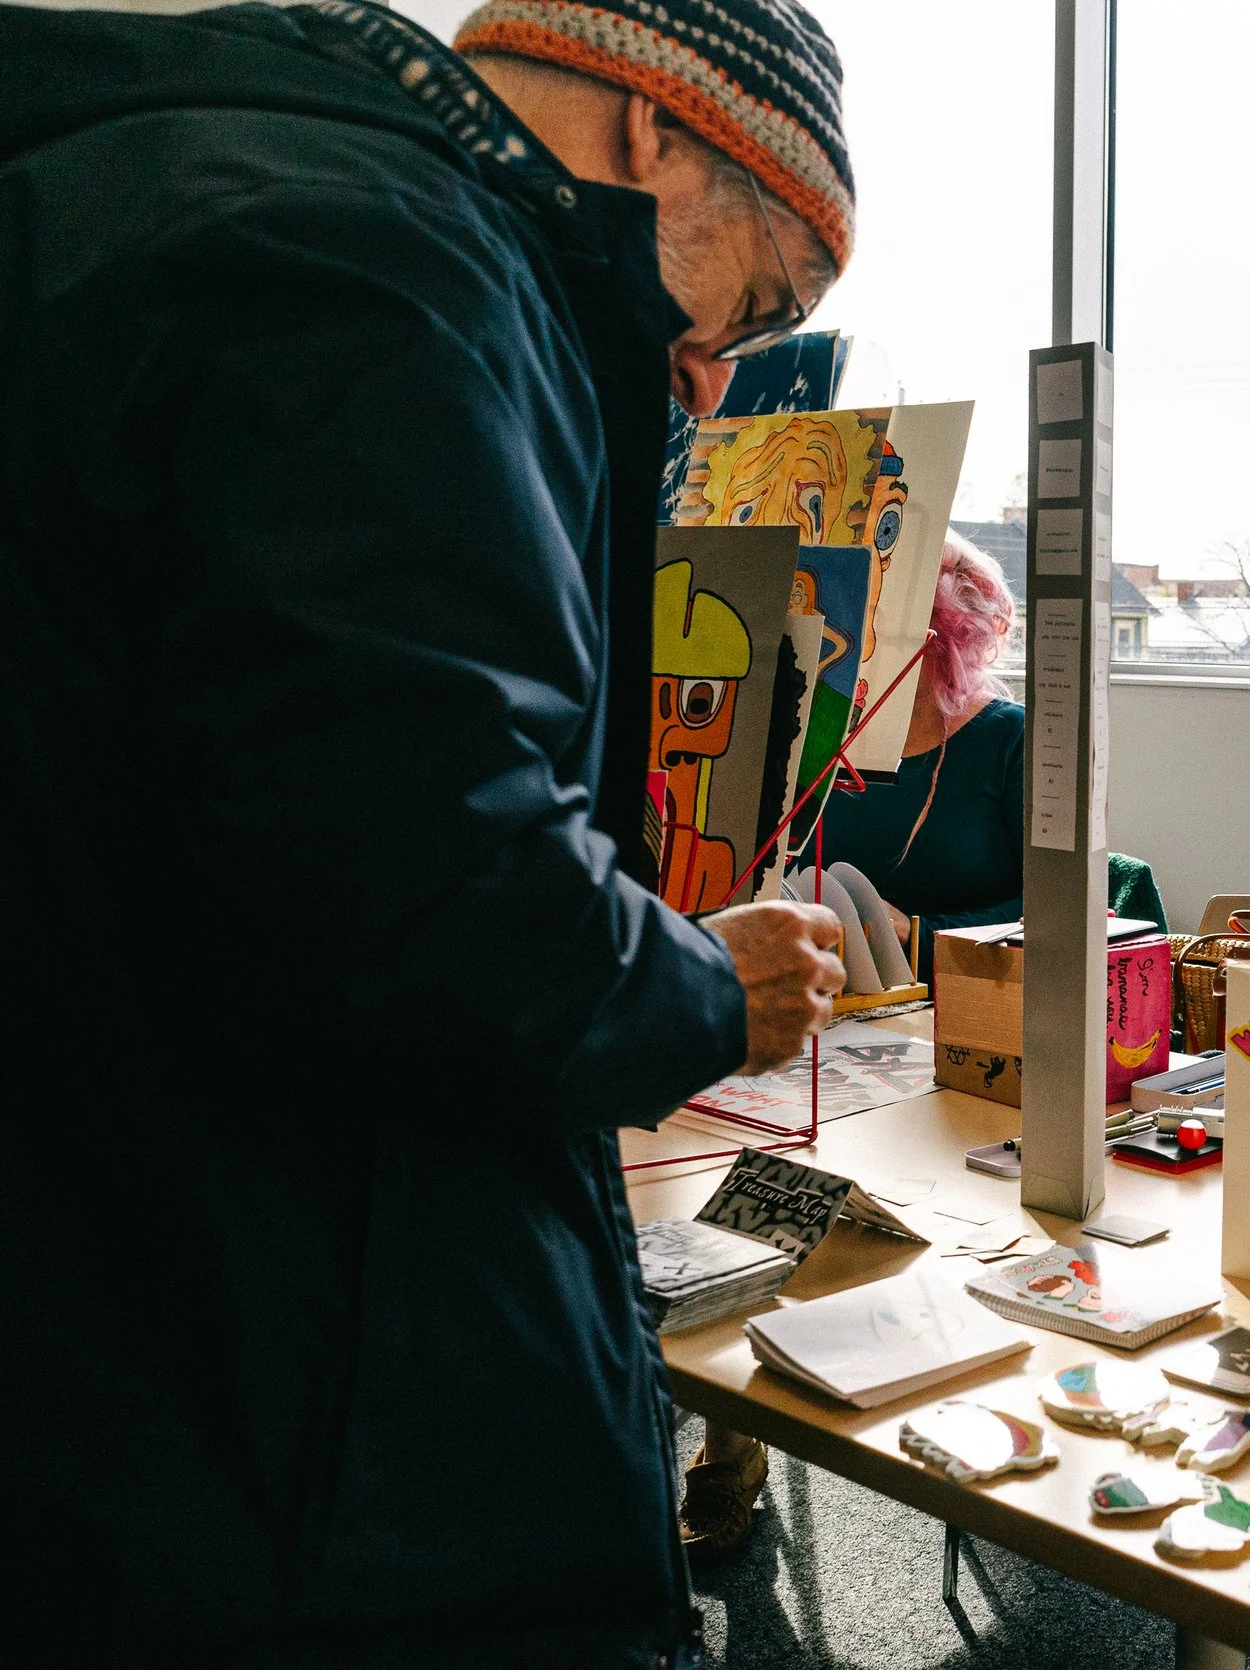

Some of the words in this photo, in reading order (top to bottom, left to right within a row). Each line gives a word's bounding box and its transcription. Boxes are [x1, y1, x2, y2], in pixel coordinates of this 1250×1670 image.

[1117, 957, 1133, 1031] bananas
[727, 1172, 789, 1204] Treasure
[787, 1194, 828, 1225] Map
